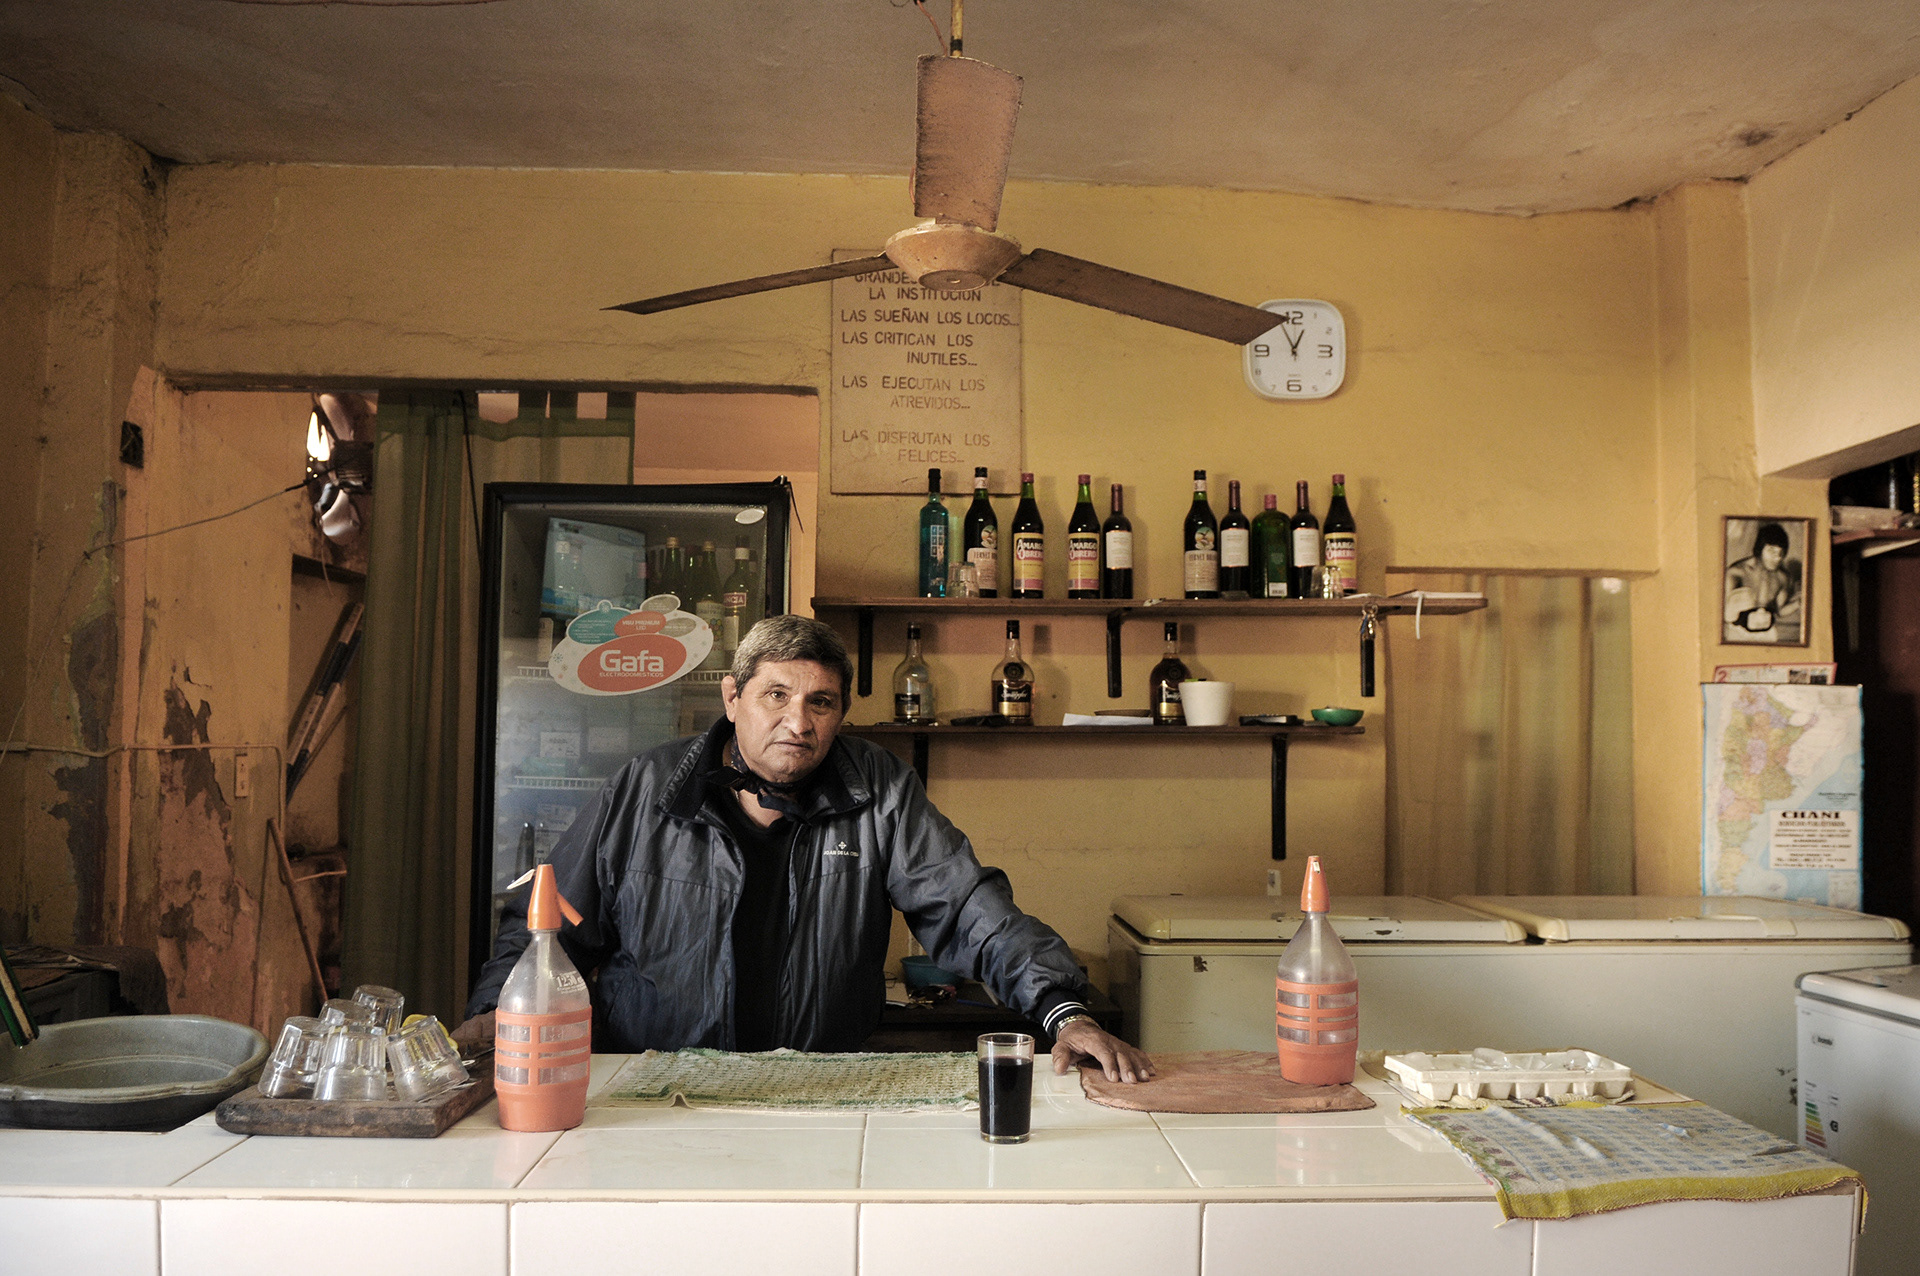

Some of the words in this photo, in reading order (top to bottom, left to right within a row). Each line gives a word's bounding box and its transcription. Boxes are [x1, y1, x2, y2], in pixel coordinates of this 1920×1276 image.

[869, 288, 886, 300] LA
[841, 309, 867, 323] LAS
[874, 307, 929, 324] SUEÑAN
[937, 312, 962, 325] LOS
[967, 312, 1020, 327] LOCOS...
[842, 331, 868, 345] LAS
[874, 331, 936, 346] CRITICAN
[947, 334, 974, 347] LOS
[907, 351, 978, 366] INUTILES...
[1254, 344, 1270, 358] 9
[1317, 344, 1333, 358] 3
[842, 375, 868, 389] LAS
[882, 375, 951, 391] EJECUTAN
[960, 378, 986, 392] LOS
[1287, 380, 1302, 392] 6
[890, 395, 971, 410] ATREVIDOS...
[842, 429, 869, 443] LAS
[877, 430, 952, 446] DISFRUTAN
[964, 433, 991, 447] LOS
[600, 649, 664, 672] Gafa
